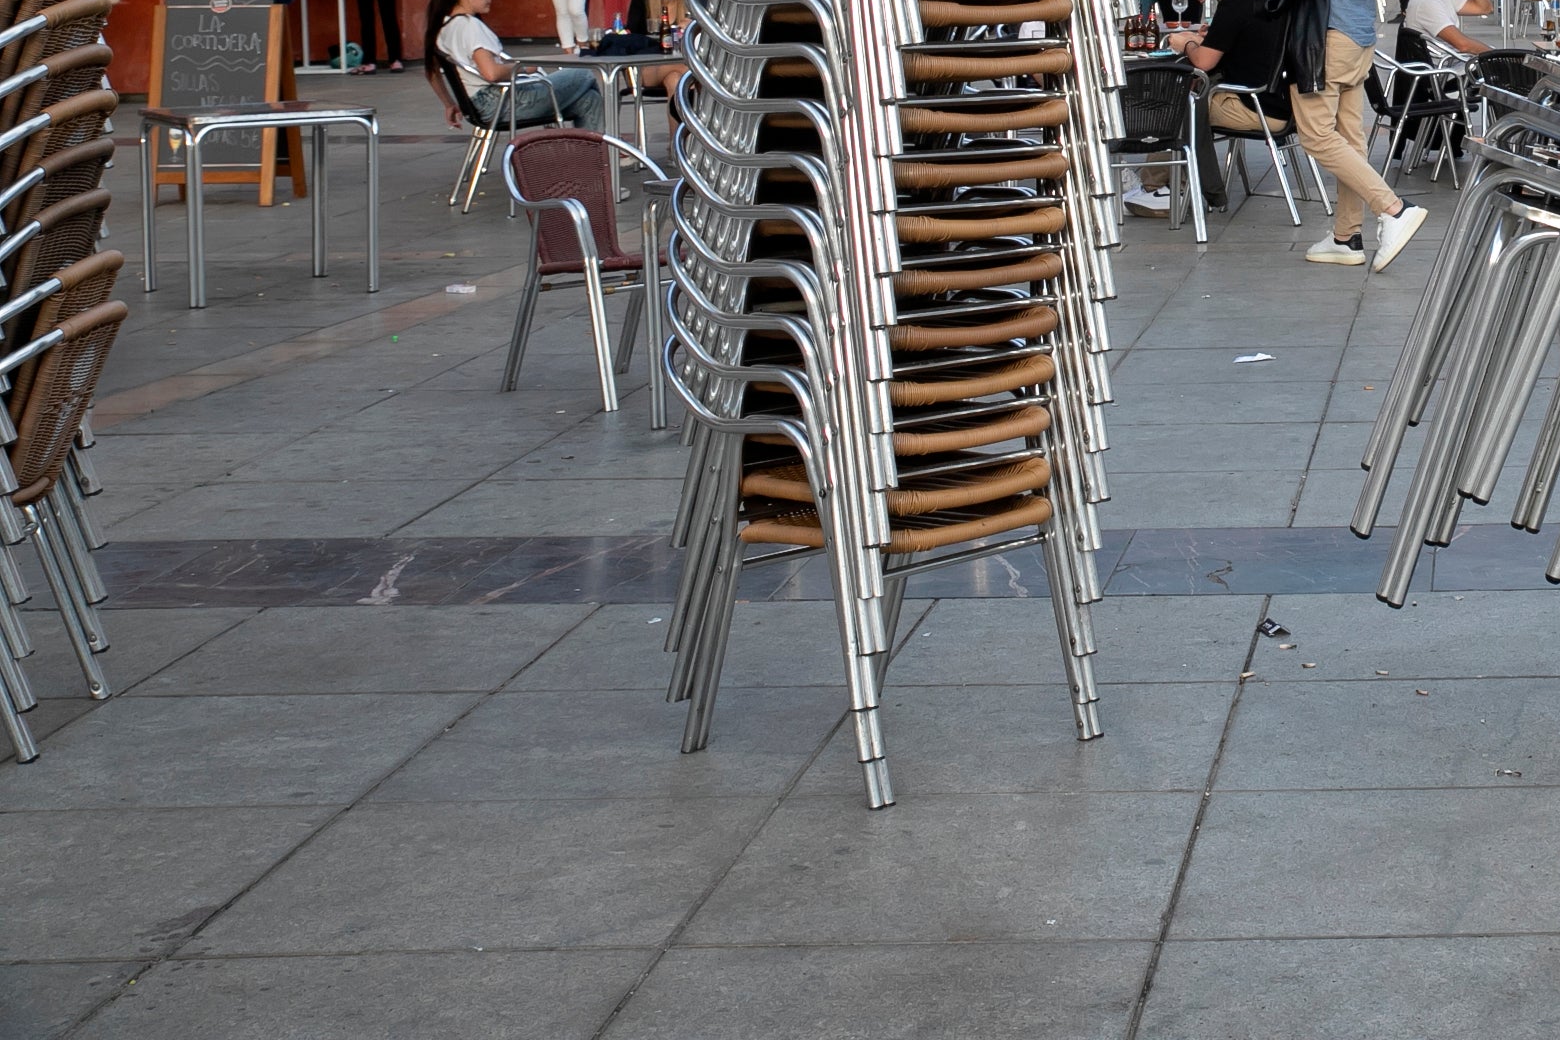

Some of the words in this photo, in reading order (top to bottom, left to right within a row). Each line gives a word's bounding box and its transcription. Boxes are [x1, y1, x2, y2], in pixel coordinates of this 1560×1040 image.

[198, 14, 226, 33] LA
[171, 33, 262, 54] CORTIJERA
[170, 70, 221, 92] SILLAS
